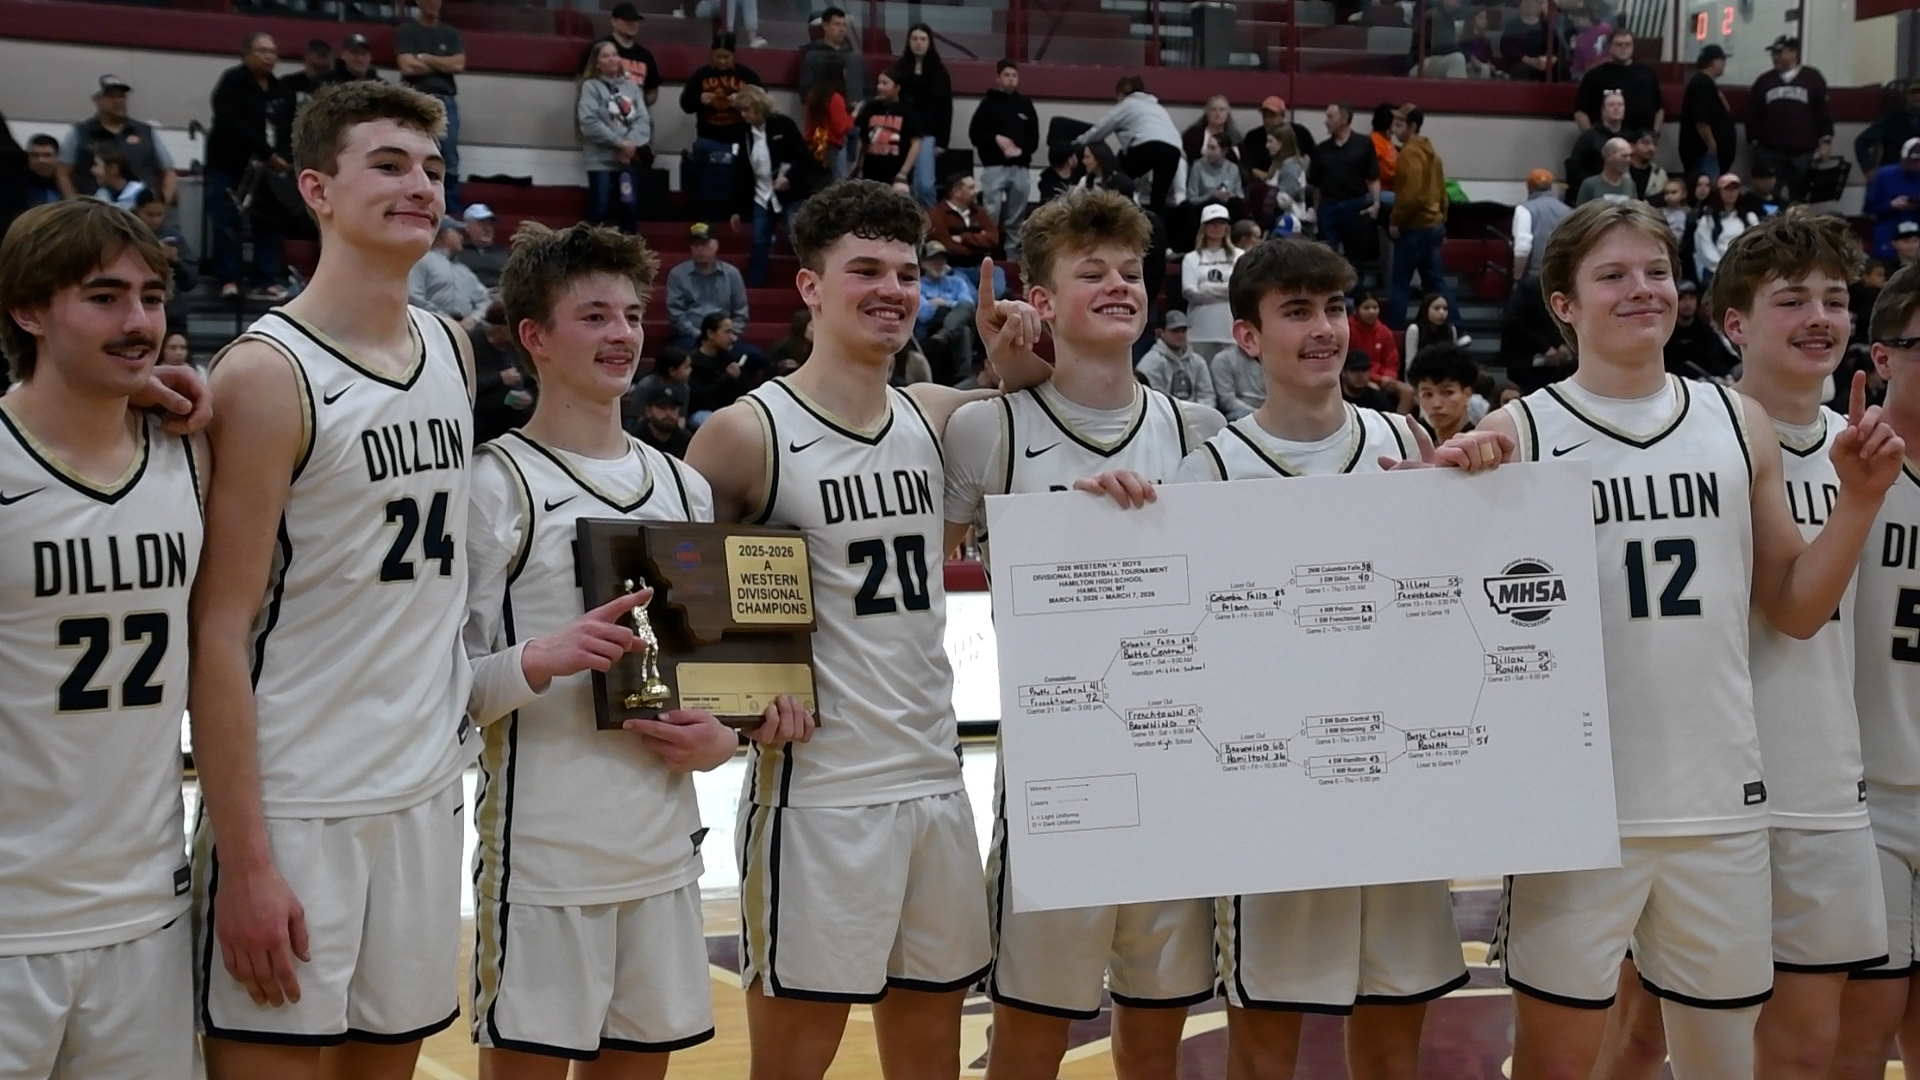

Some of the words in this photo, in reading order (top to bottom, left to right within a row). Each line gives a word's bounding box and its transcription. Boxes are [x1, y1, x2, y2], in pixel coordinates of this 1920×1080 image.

[1696, 11, 1709, 41] 0
[1721, 6, 1735, 36] 2
[361, 418, 465, 482] DILLON
[819, 470, 934, 525] DILLON
[1592, 472, 1719, 525] DILLON
[377, 490, 455, 584] 24
[738, 544, 794, 558] 2025-2026
[33, 532, 187, 598] DILLON
[763, 559, 773, 572] A
[1073, 562, 1107, 571] WESTERN
[1122, 560, 1142, 568] BOYS
[740, 573, 798, 586] WESTERN
[845, 532, 932, 619] 20
[1033, 572, 1073, 582] DIVISIONAL
[1073, 569, 1119, 579] BASKETBALL
[1121, 566, 1169, 575] TOURNAMENT
[1621, 535, 1704, 622] 12
[1058, 579, 1095, 588] HAMILTON
[1114, 576, 1143, 584] SCHOOL
[737, 587, 804, 601] DIVISIONAL
[1077, 586, 1115, 594] HAMILTON,
[1083, 594, 1099, 602] 2026
[1105, 593, 1131, 601] MARCH
[1140, 591, 1156, 599] 2026
[1305, 587, 1321, 595] Game
[1499, 579, 1567, 604] MHSA
[736, 602, 808, 615] CHAMPIONS
[1123, 648, 1149, 660] Butte
[1497, 644, 1536, 652] Championship
[55, 608, 170, 714] 22
[1026, 707, 1046, 715] Game
